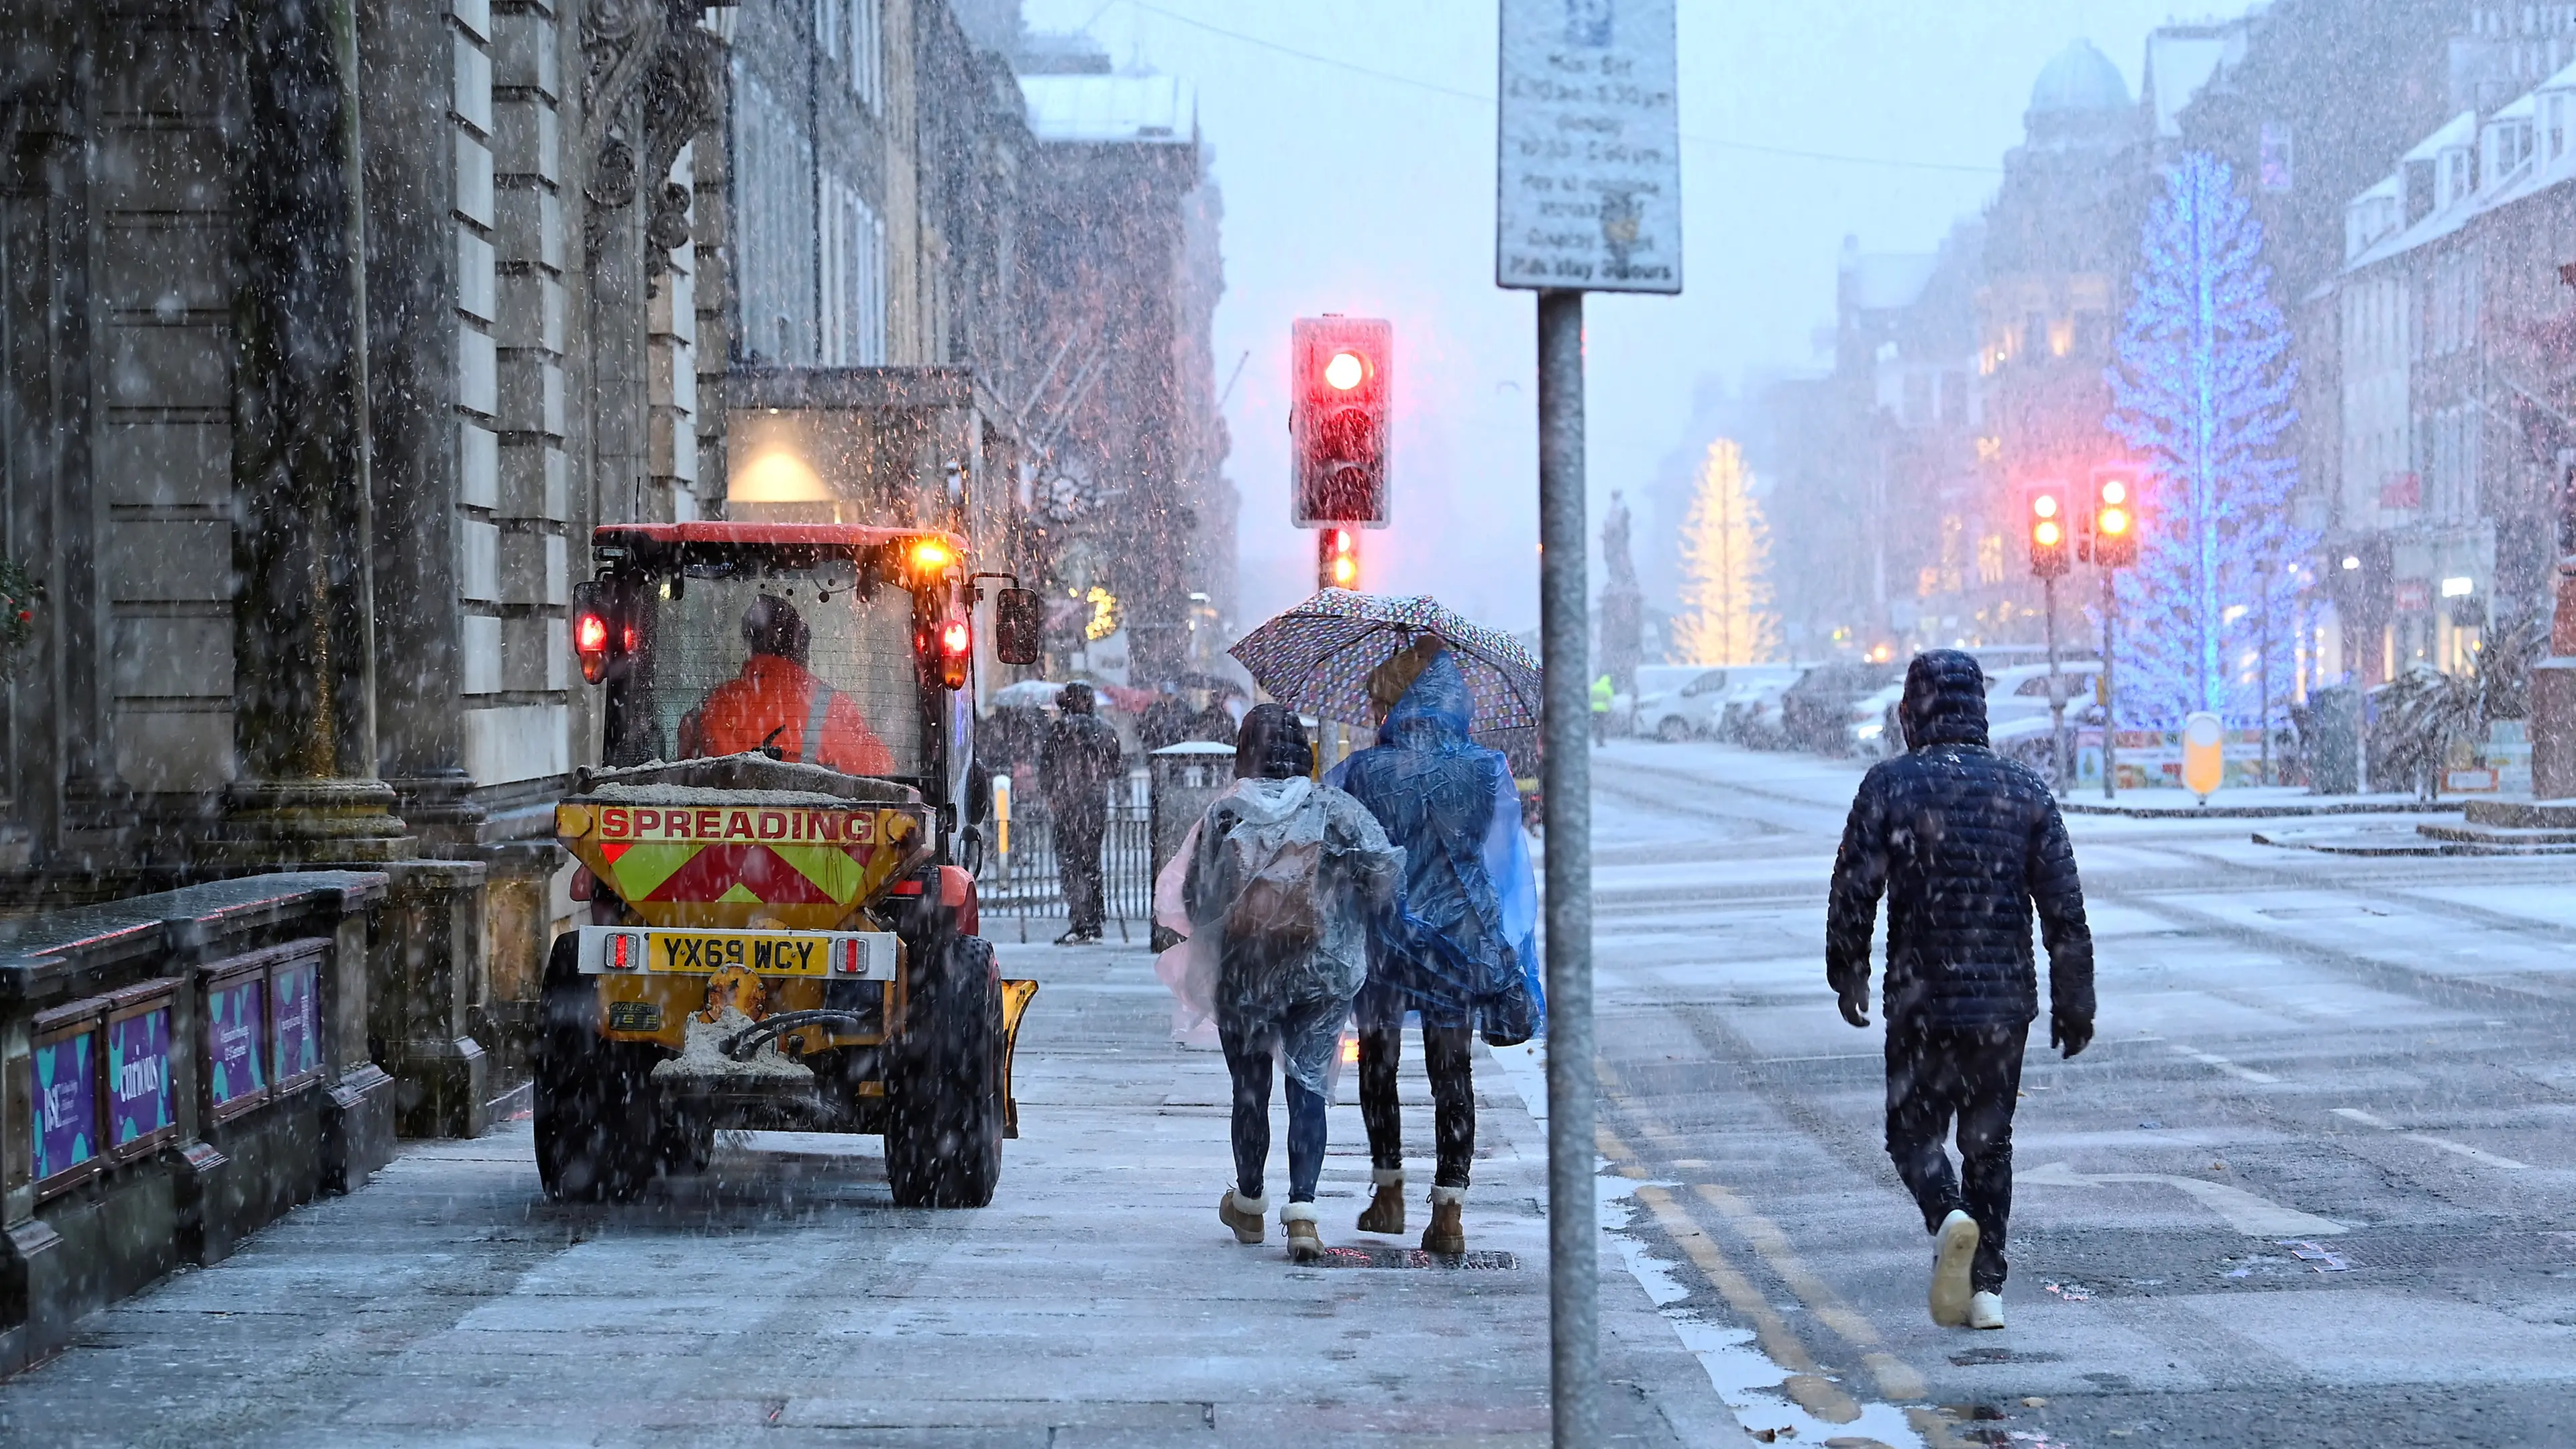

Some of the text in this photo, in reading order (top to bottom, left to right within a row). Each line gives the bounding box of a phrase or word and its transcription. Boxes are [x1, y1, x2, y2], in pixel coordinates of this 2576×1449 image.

[602, 808, 872, 841] SPREADING
[663, 938, 814, 970] YX69 WCY
[616, 1002, 643, 1012] VALE
